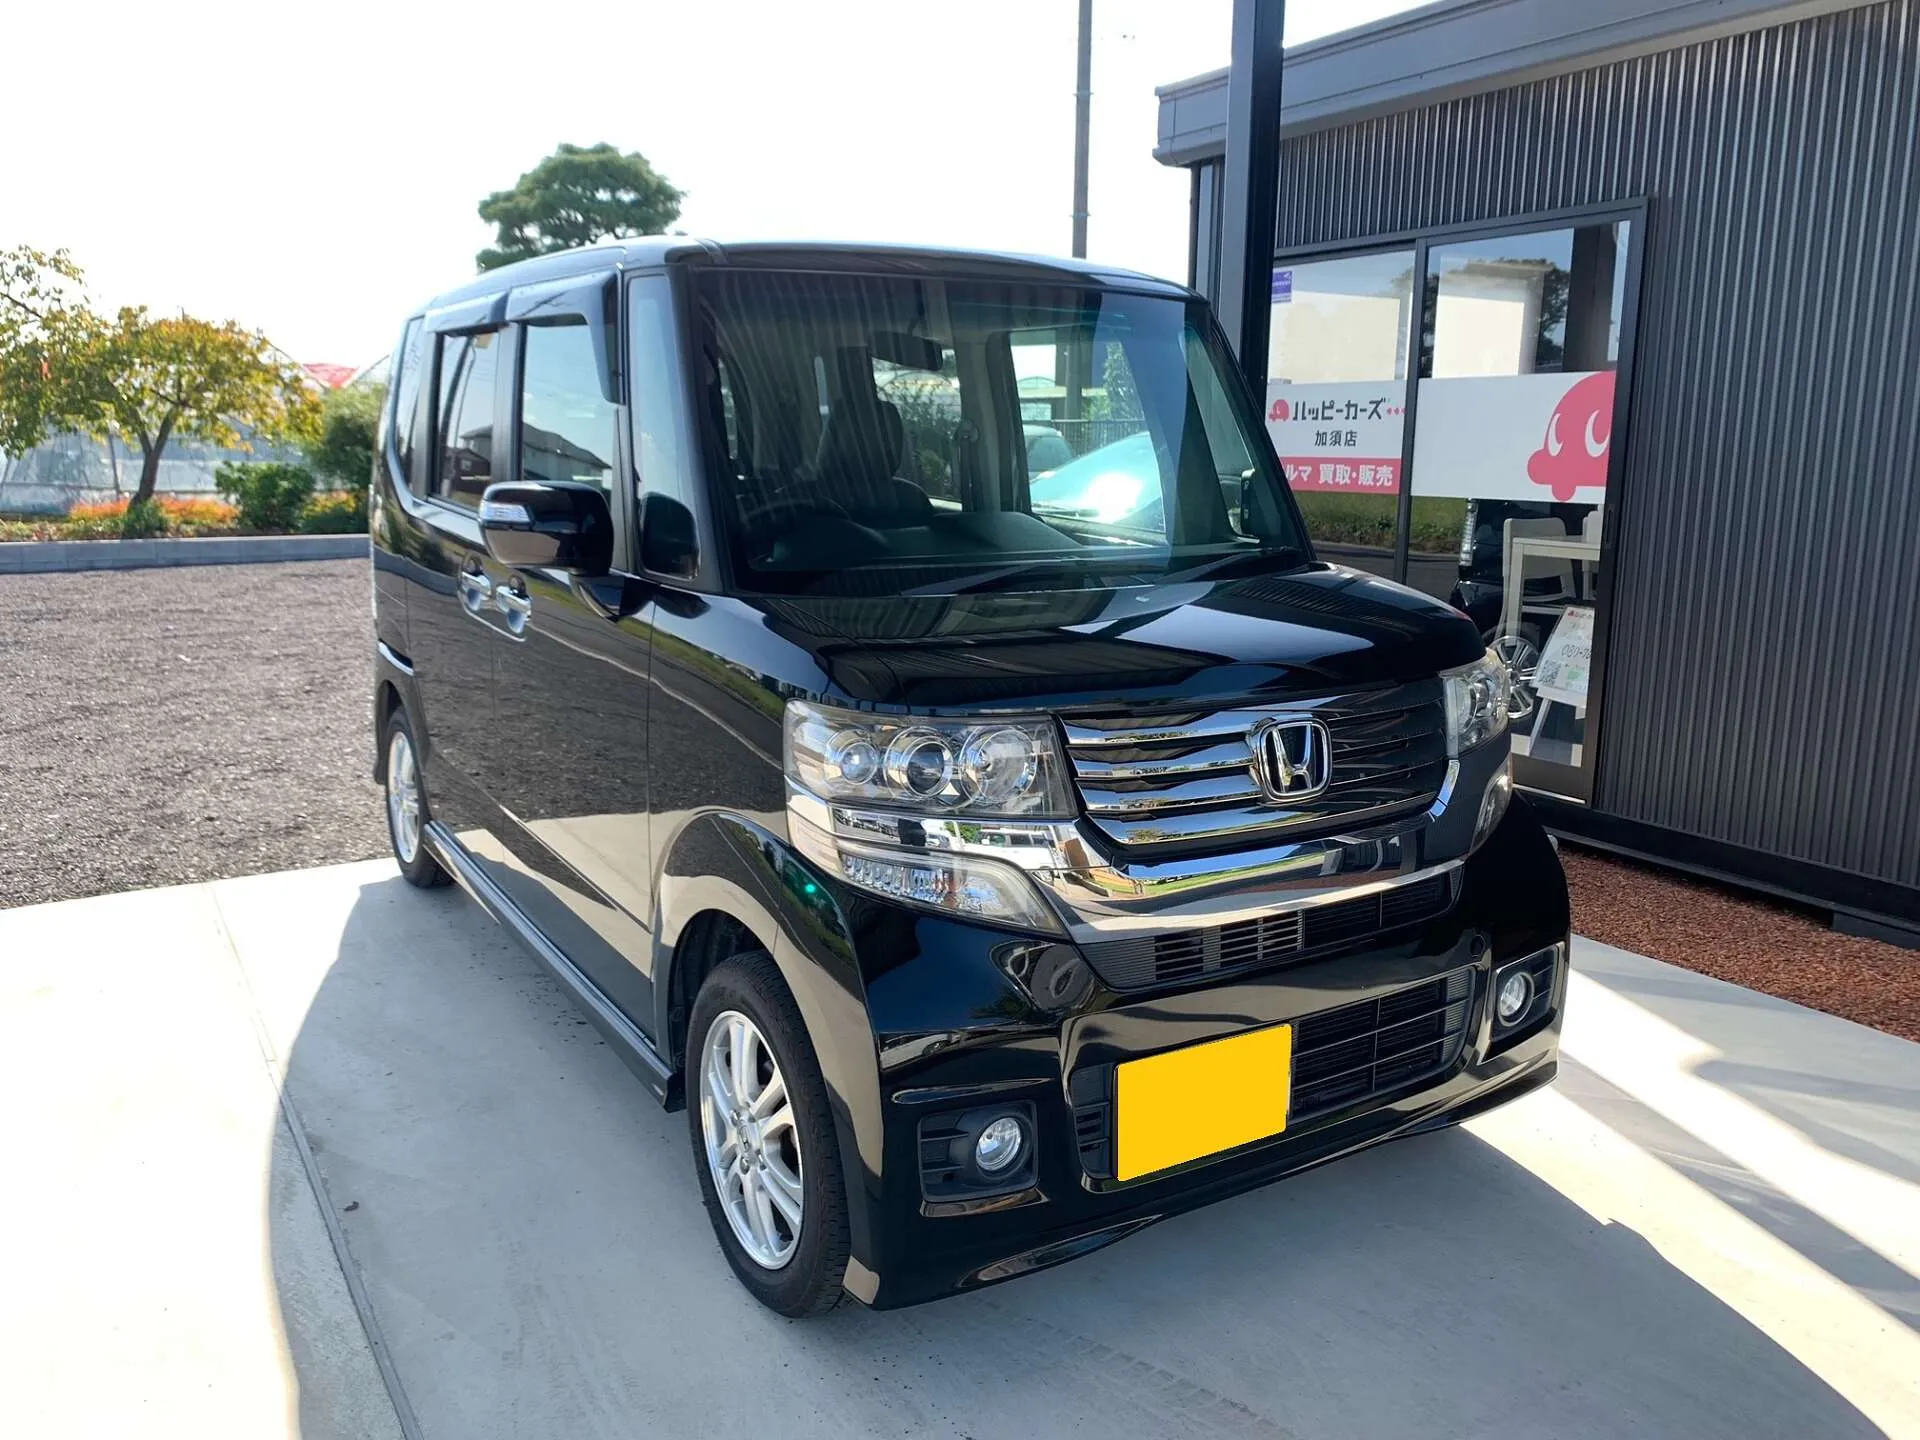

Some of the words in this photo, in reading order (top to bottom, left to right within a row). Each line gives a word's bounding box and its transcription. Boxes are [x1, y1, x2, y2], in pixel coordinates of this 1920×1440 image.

[1292, 397, 1386, 421] ハッピーカーズ
[1314, 430, 1358, 447] 加須店
[1284, 463, 1312, 482] ルマ
